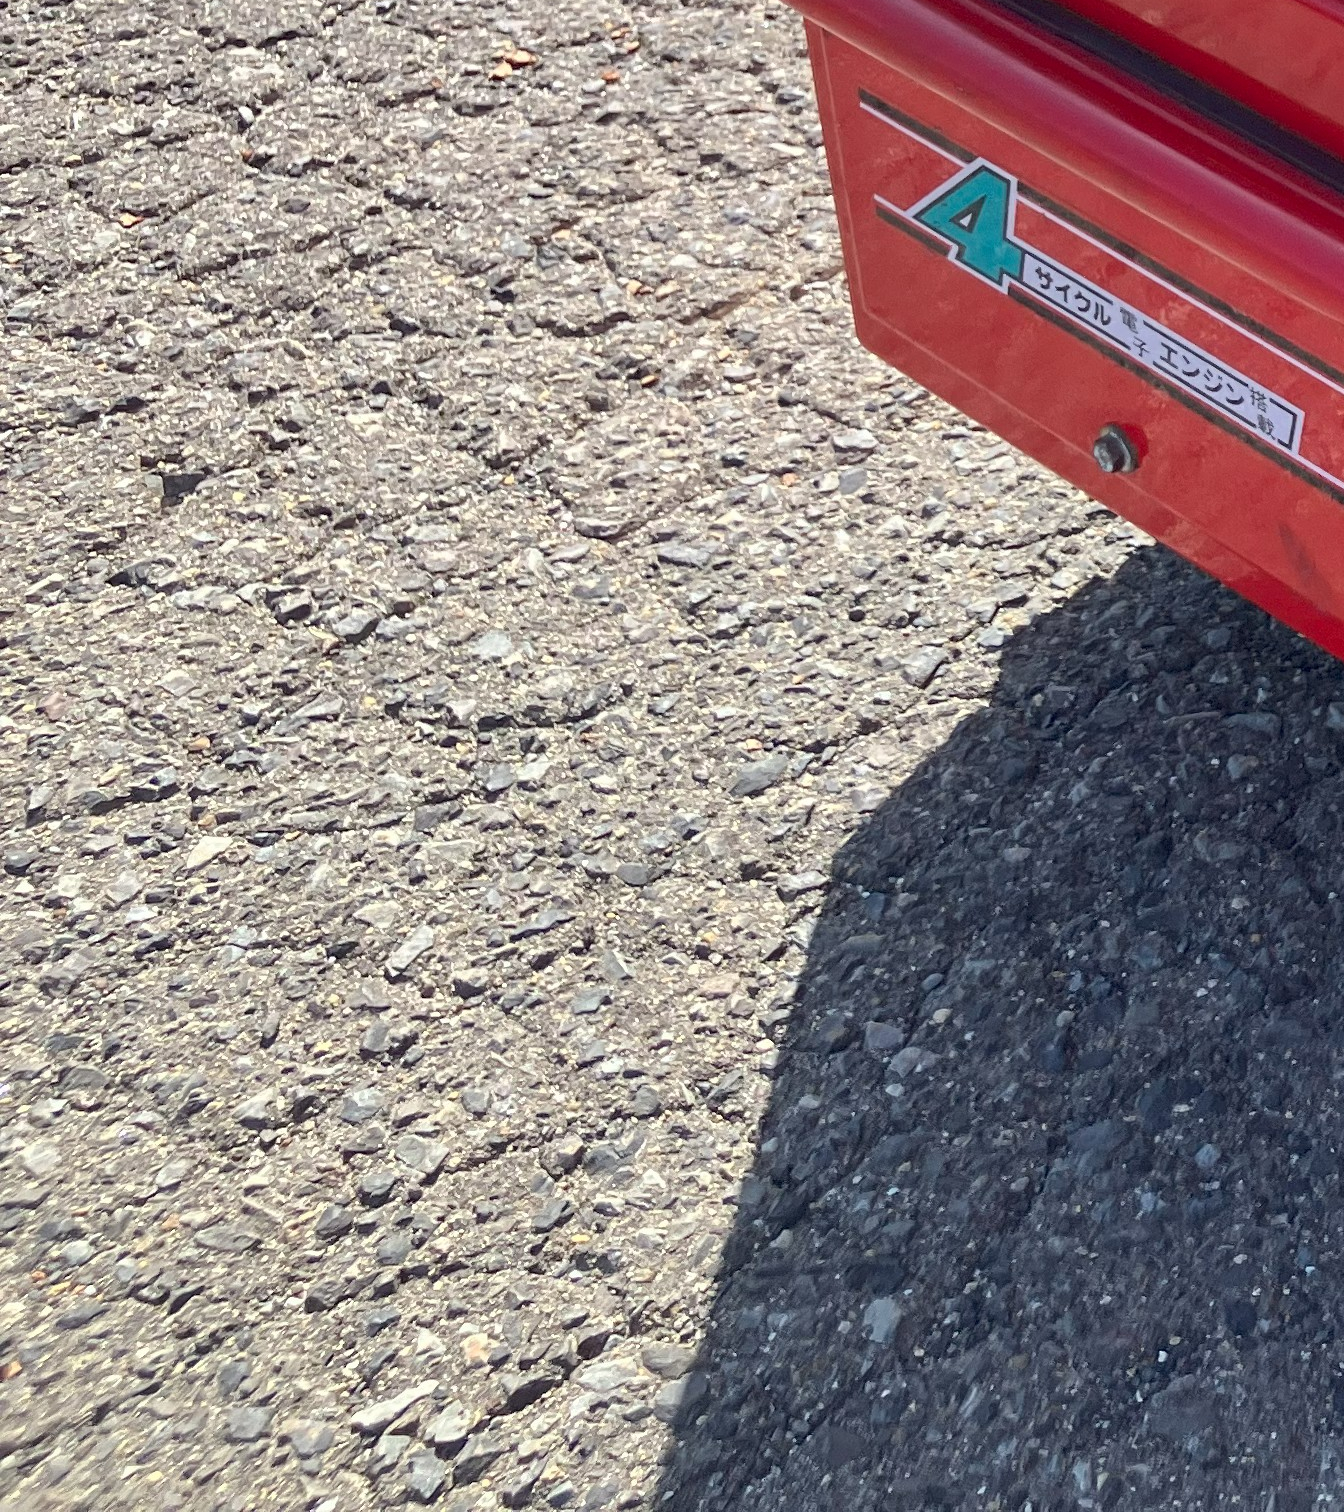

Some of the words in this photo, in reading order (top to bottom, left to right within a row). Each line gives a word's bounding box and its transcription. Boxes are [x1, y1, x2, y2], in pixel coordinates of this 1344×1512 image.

[912, 162, 1024, 287] 4
[1035, 266, 1112, 327] サイクル
[1159, 341, 1245, 406] エンジン
